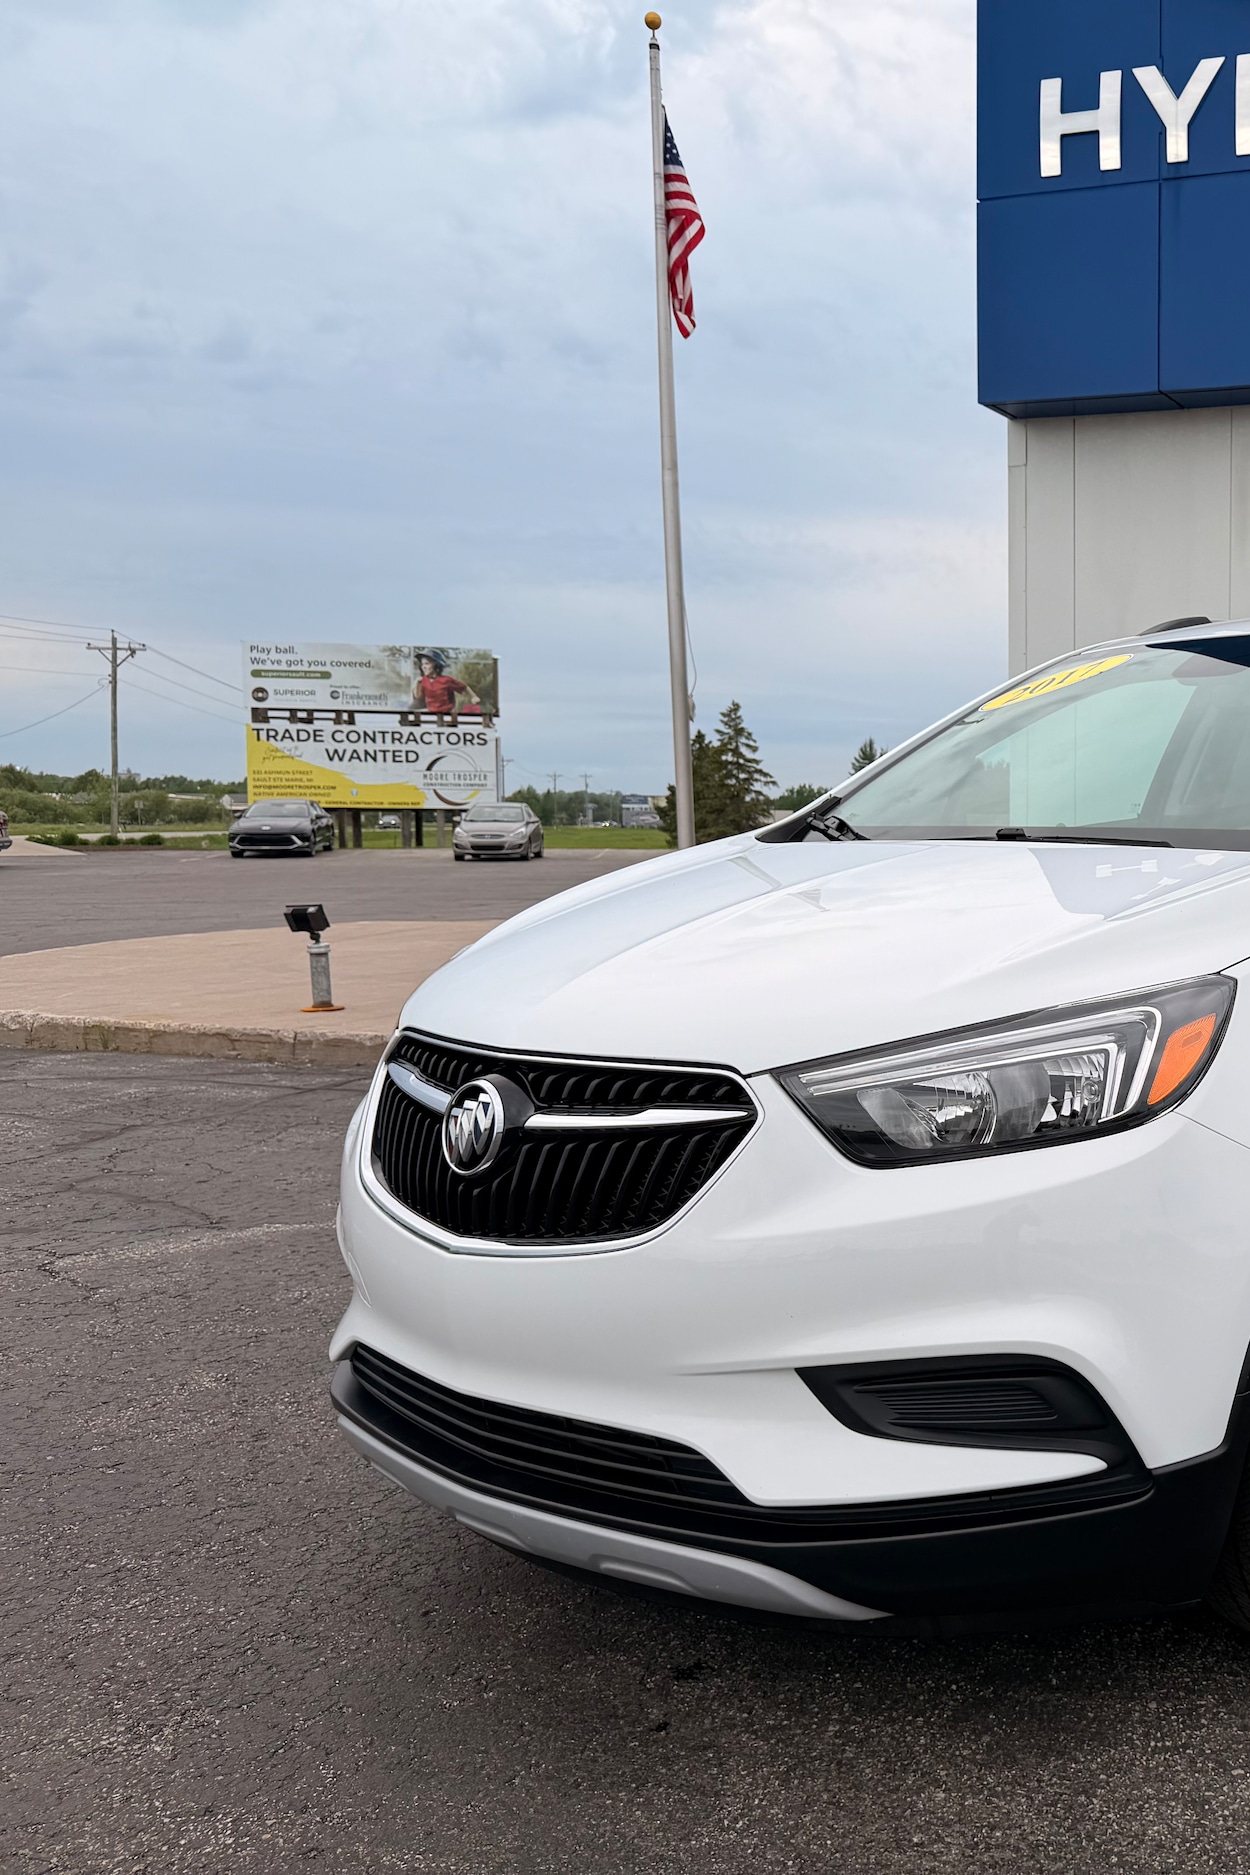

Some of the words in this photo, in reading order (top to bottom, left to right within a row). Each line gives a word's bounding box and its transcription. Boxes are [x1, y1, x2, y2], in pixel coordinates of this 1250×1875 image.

[250, 645, 272, 656] Play
[275, 645, 298, 655] ball.
[250, 657, 283, 666] We've
[285, 658, 304, 667] got
[307, 660, 327, 668] you
[330, 659, 374, 669] covered.
[1004, 658, 1109, 704] 2017
[252, 728, 325, 743] TRADE
[331, 729, 488, 746] CONTRACTORS
[325, 747, 420, 763] WANTED
[423, 773, 448, 781] MOORE
[453, 773, 488, 781] TROSPER
